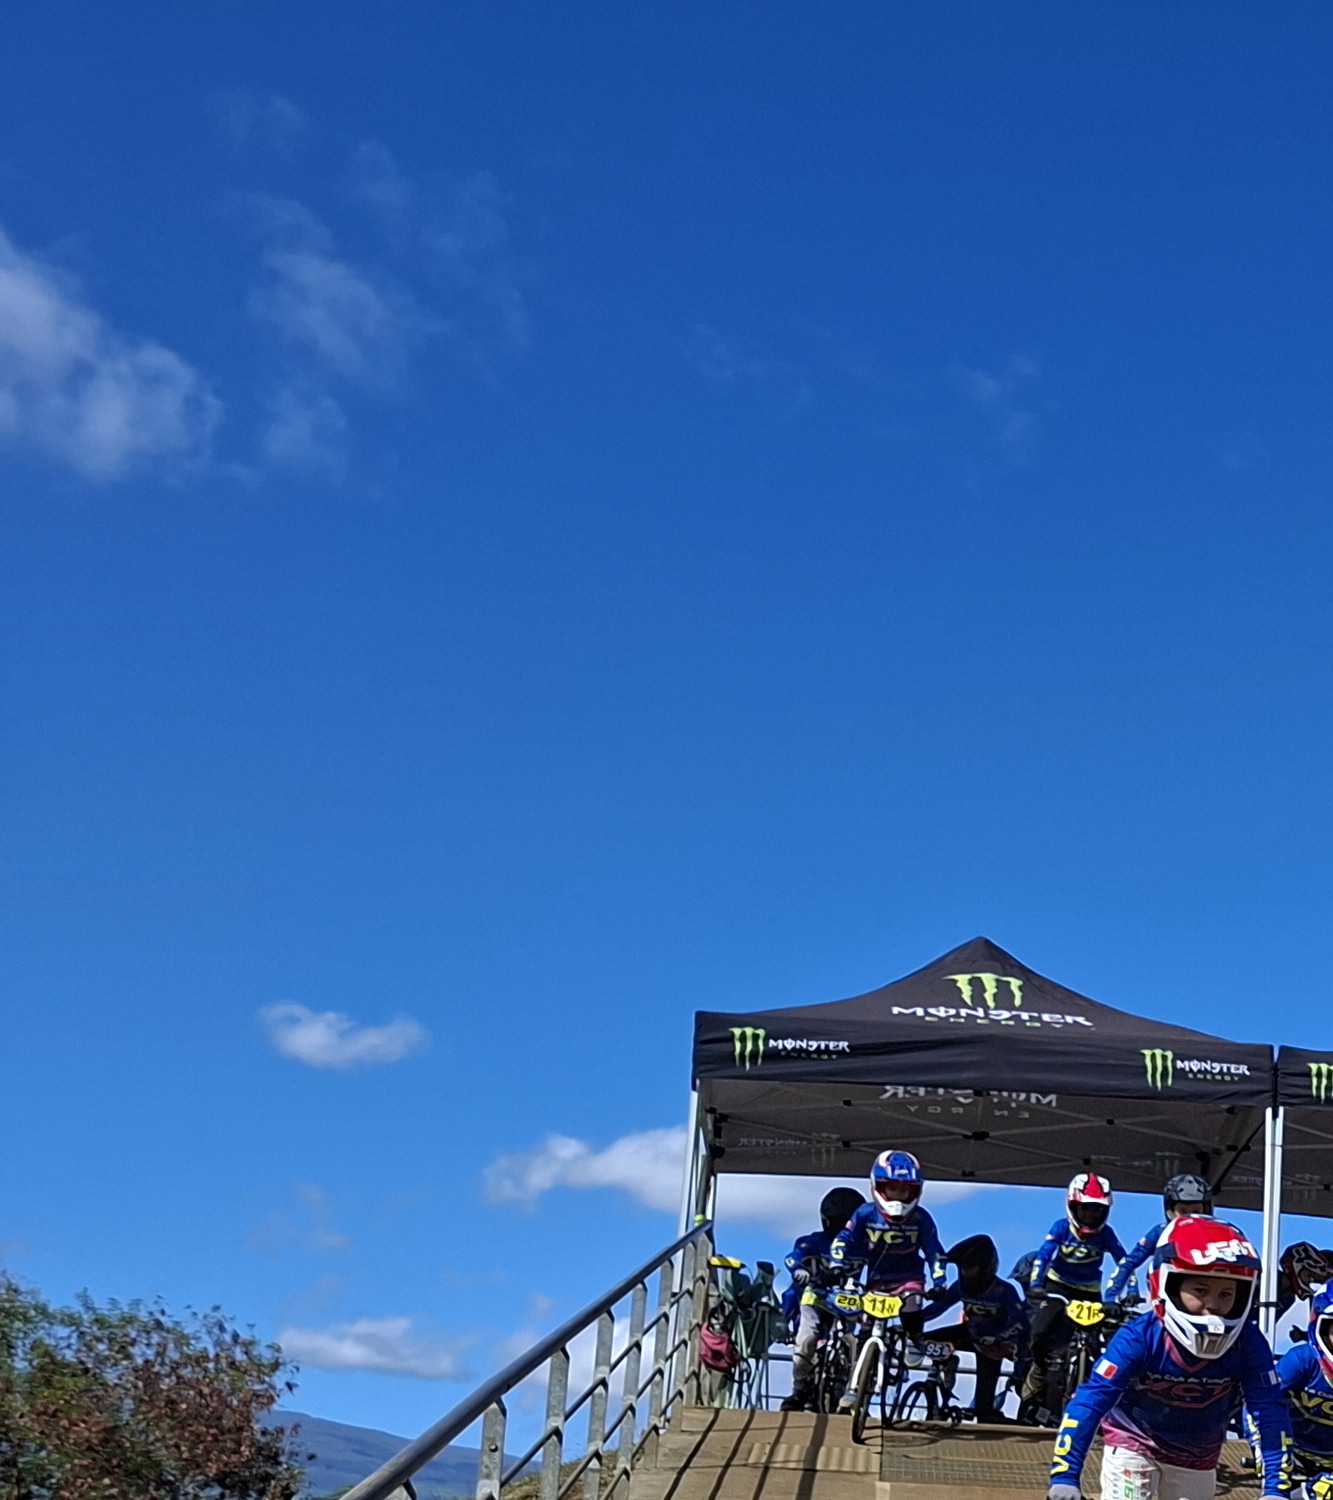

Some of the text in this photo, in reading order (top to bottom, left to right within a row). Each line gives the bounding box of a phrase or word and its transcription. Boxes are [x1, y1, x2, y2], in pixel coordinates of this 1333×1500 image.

[890, 1006, 1095, 1027] MONSTER
[768, 1038, 850, 1053] MONSTER
[1175, 1059, 1251, 1077] MONSTER
[865, 1228, 919, 1244] VCT
[1050, 1412, 1079, 1475] VCT
